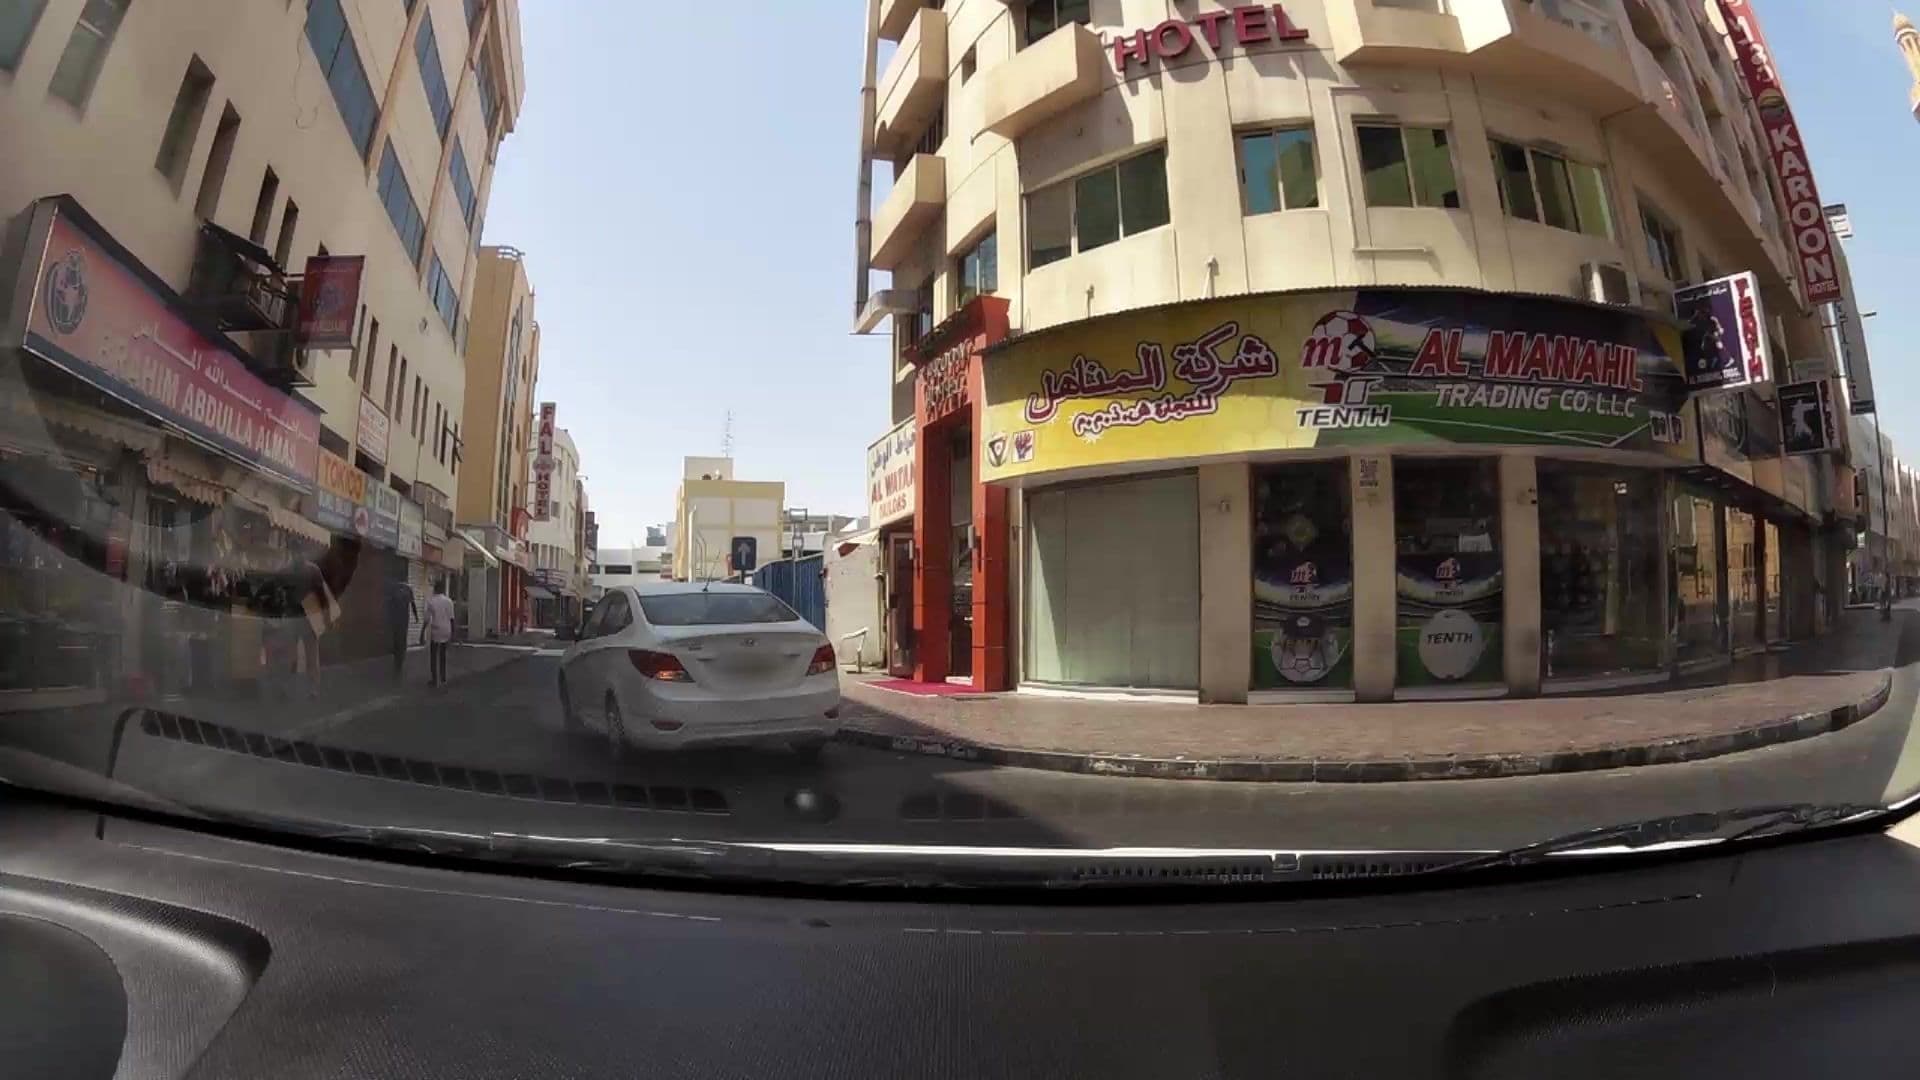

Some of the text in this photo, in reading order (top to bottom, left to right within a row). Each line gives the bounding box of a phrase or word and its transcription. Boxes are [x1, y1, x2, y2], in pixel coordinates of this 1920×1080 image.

[1114, 4, 1309, 72] HOTEL
[1770, 124, 1835, 283] KAROON
[1808, 279, 1839, 294] HOTEL
[1025, 321, 1279, 423] شركة المناهل
[1408, 327, 1644, 393] AL MANAHIL
[181, 382, 252, 449] ABDULLA
[1296, 404, 1392, 428] TENTH
[1435, 383, 1553, 411] TRADING
[1560, 389, 1592, 415] CO.
[540, 406, 553, 455] FAL
[537, 473, 550, 516] HOTEL
[871, 479, 883, 503] AL
[1427, 631, 1473, 645] TENTH
